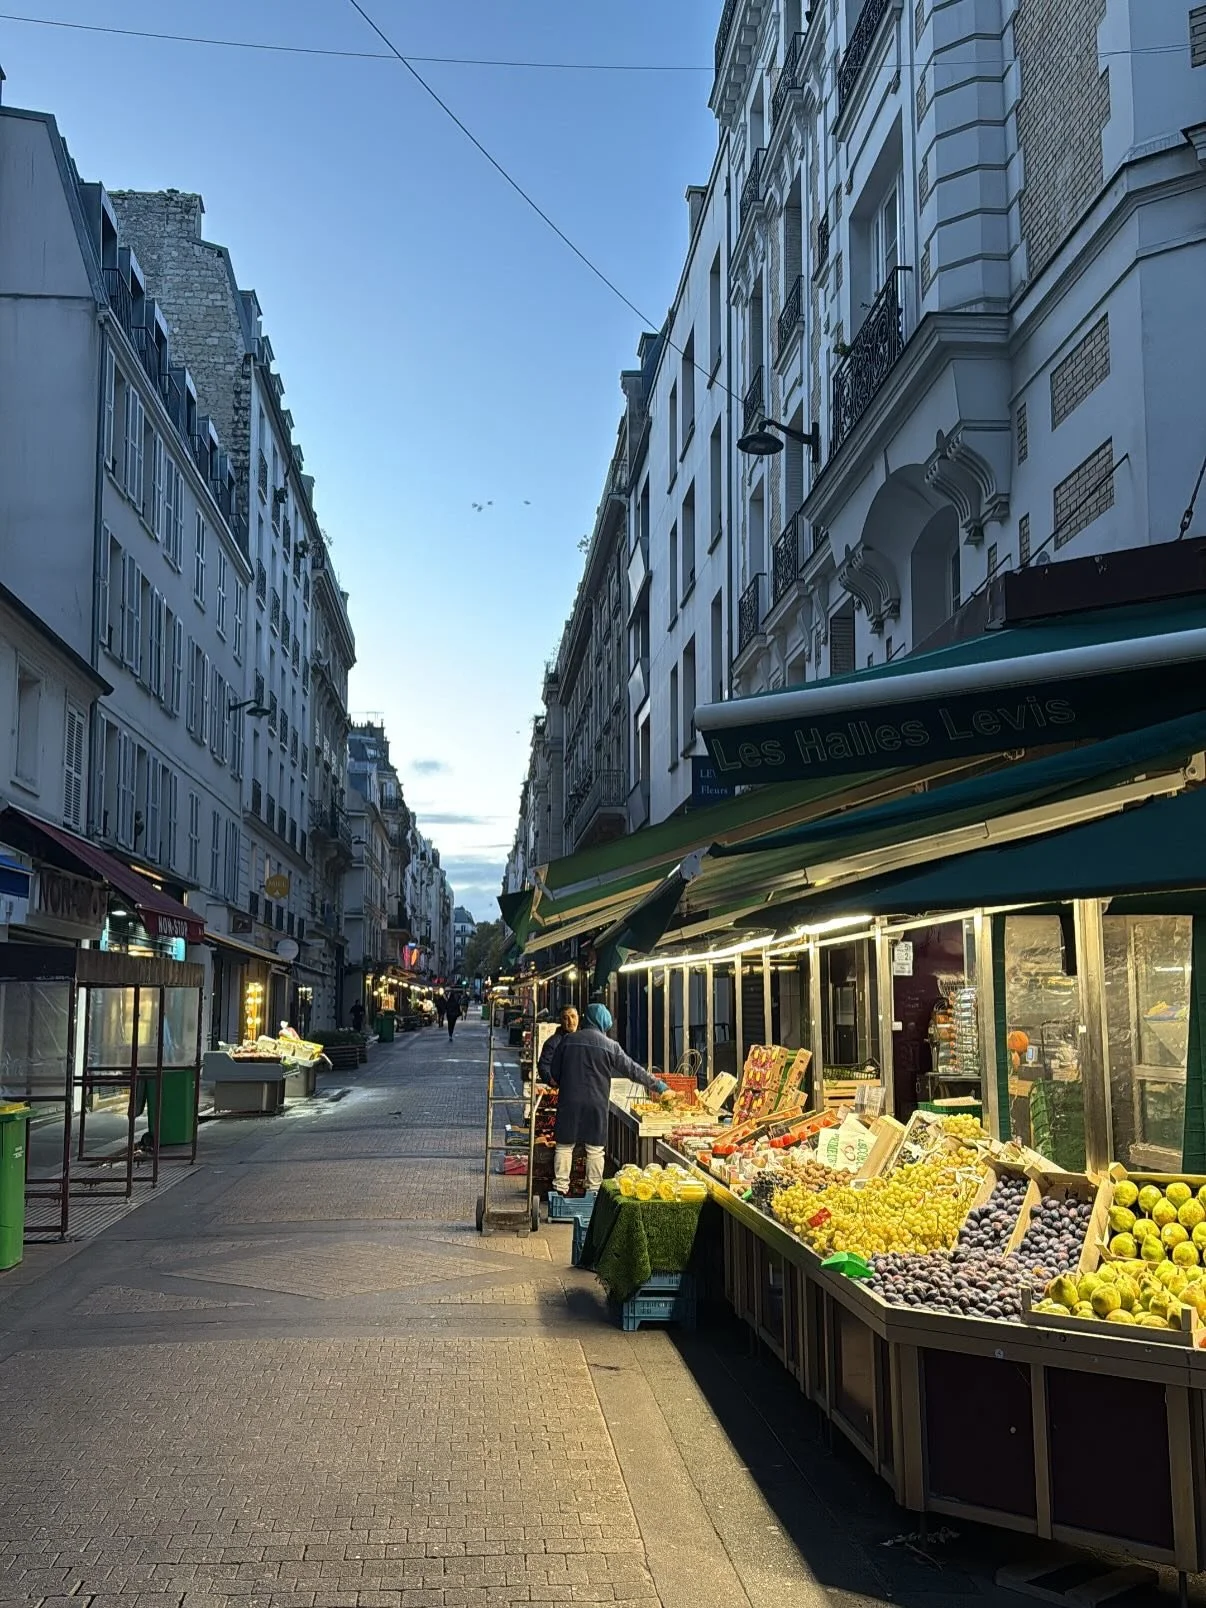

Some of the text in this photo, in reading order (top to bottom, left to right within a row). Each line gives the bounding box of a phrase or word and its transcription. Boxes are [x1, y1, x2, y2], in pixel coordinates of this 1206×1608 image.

[710, 695, 1076, 772] Les Halles Levis
[701, 784, 729, 795] Fleurs
[158, 915, 188, 937] NON-STOP
